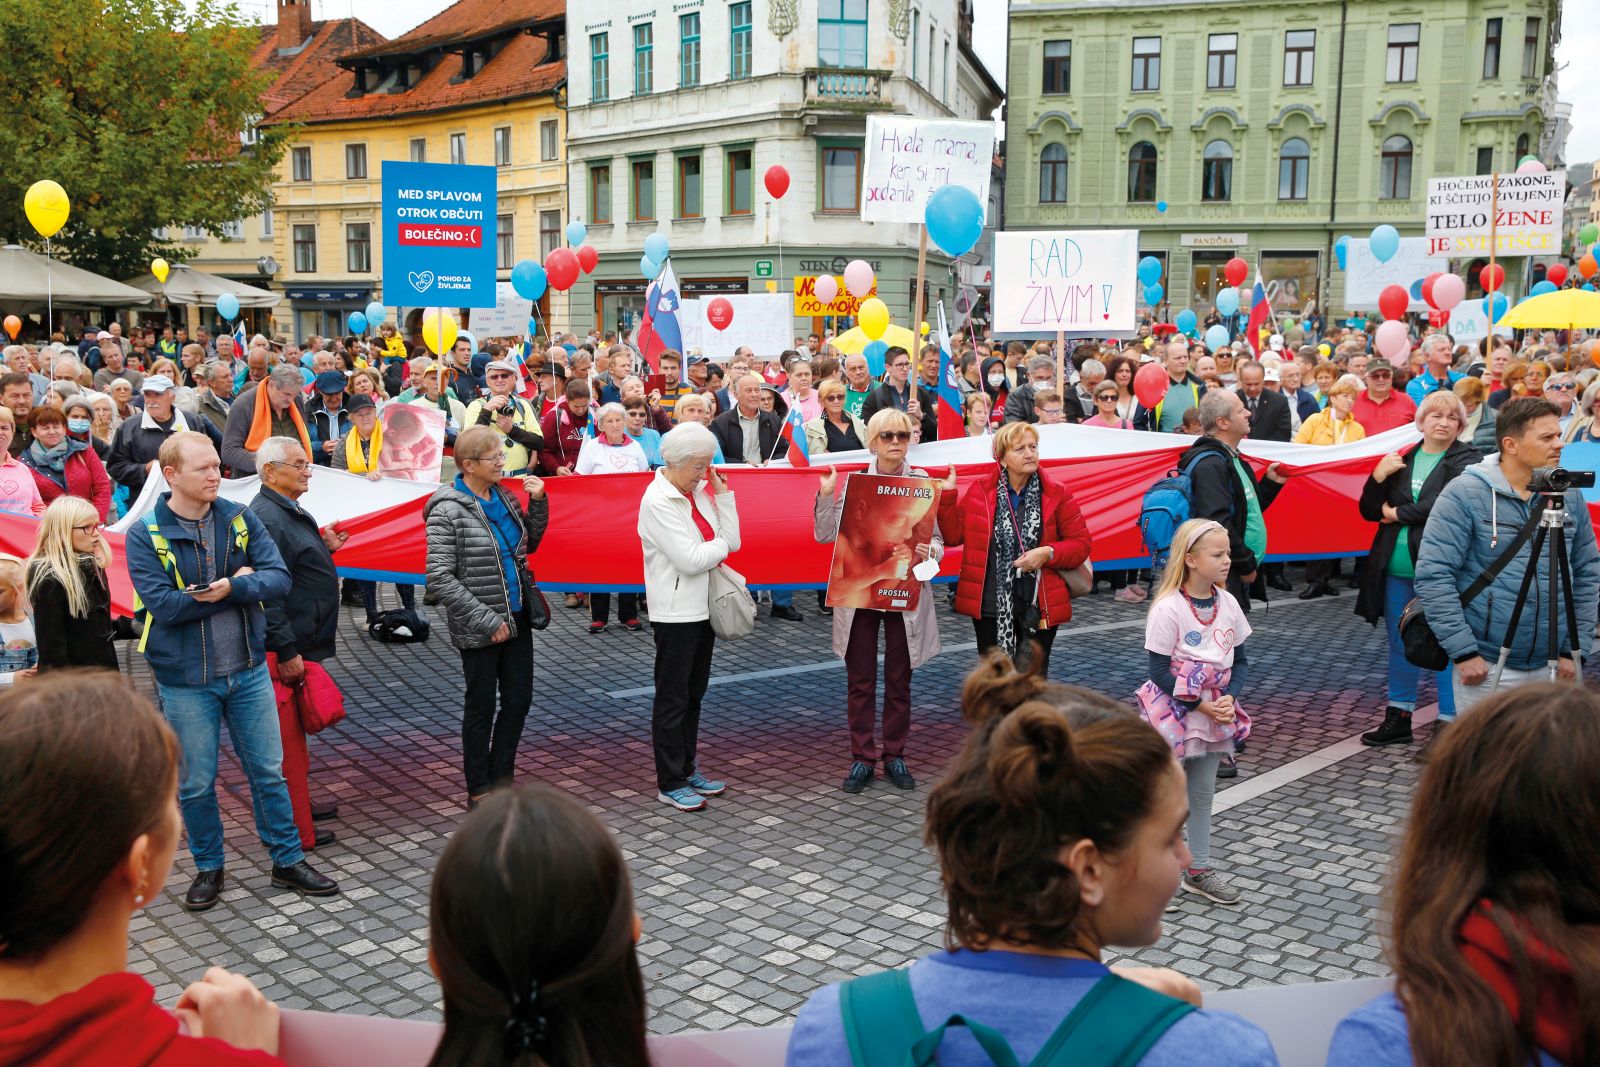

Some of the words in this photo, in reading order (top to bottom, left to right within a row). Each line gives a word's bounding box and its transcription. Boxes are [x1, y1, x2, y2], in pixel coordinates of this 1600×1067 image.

[881, 127, 924, 153] Hvala
[933, 138, 978, 165] mama,
[889, 156, 912, 180] ker
[916, 162, 928, 181] si
[934, 162, 950, 185] mi
[1437, 179, 1494, 191] HOČEMO
[1496, 175, 1555, 188] ZAKONE,
[398, 188, 424, 200] MED
[425, 190, 482, 202] SPLAVOM
[865, 181, 915, 211] podarila
[1430, 195, 1441, 205] KI
[1445, 192, 1491, 206] ŠČITIJO
[1495, 188, 1561, 203] ŽIVLJENJE
[397, 207, 438, 219] OTROK
[440, 207, 483, 220] OBČUTI
[1430, 213, 1487, 229] TELO
[1495, 208, 1553, 227] ŽENE
[405, 228, 463, 241] BOLEČINO
[1193, 236, 1233, 244] PANDORA
[1428, 237, 1450, 256] JE
[1455, 230, 1554, 251] SVETIŠČE
[800, 260, 829, 271] STEN
[1030, 238, 1083, 278] RAD
[437, 282, 472, 290] ŽIVLJENJE
[1455, 318, 1477, 335] DA
[877, 485, 911, 497] BRANI
[877, 588, 911, 598] PROSIM.
